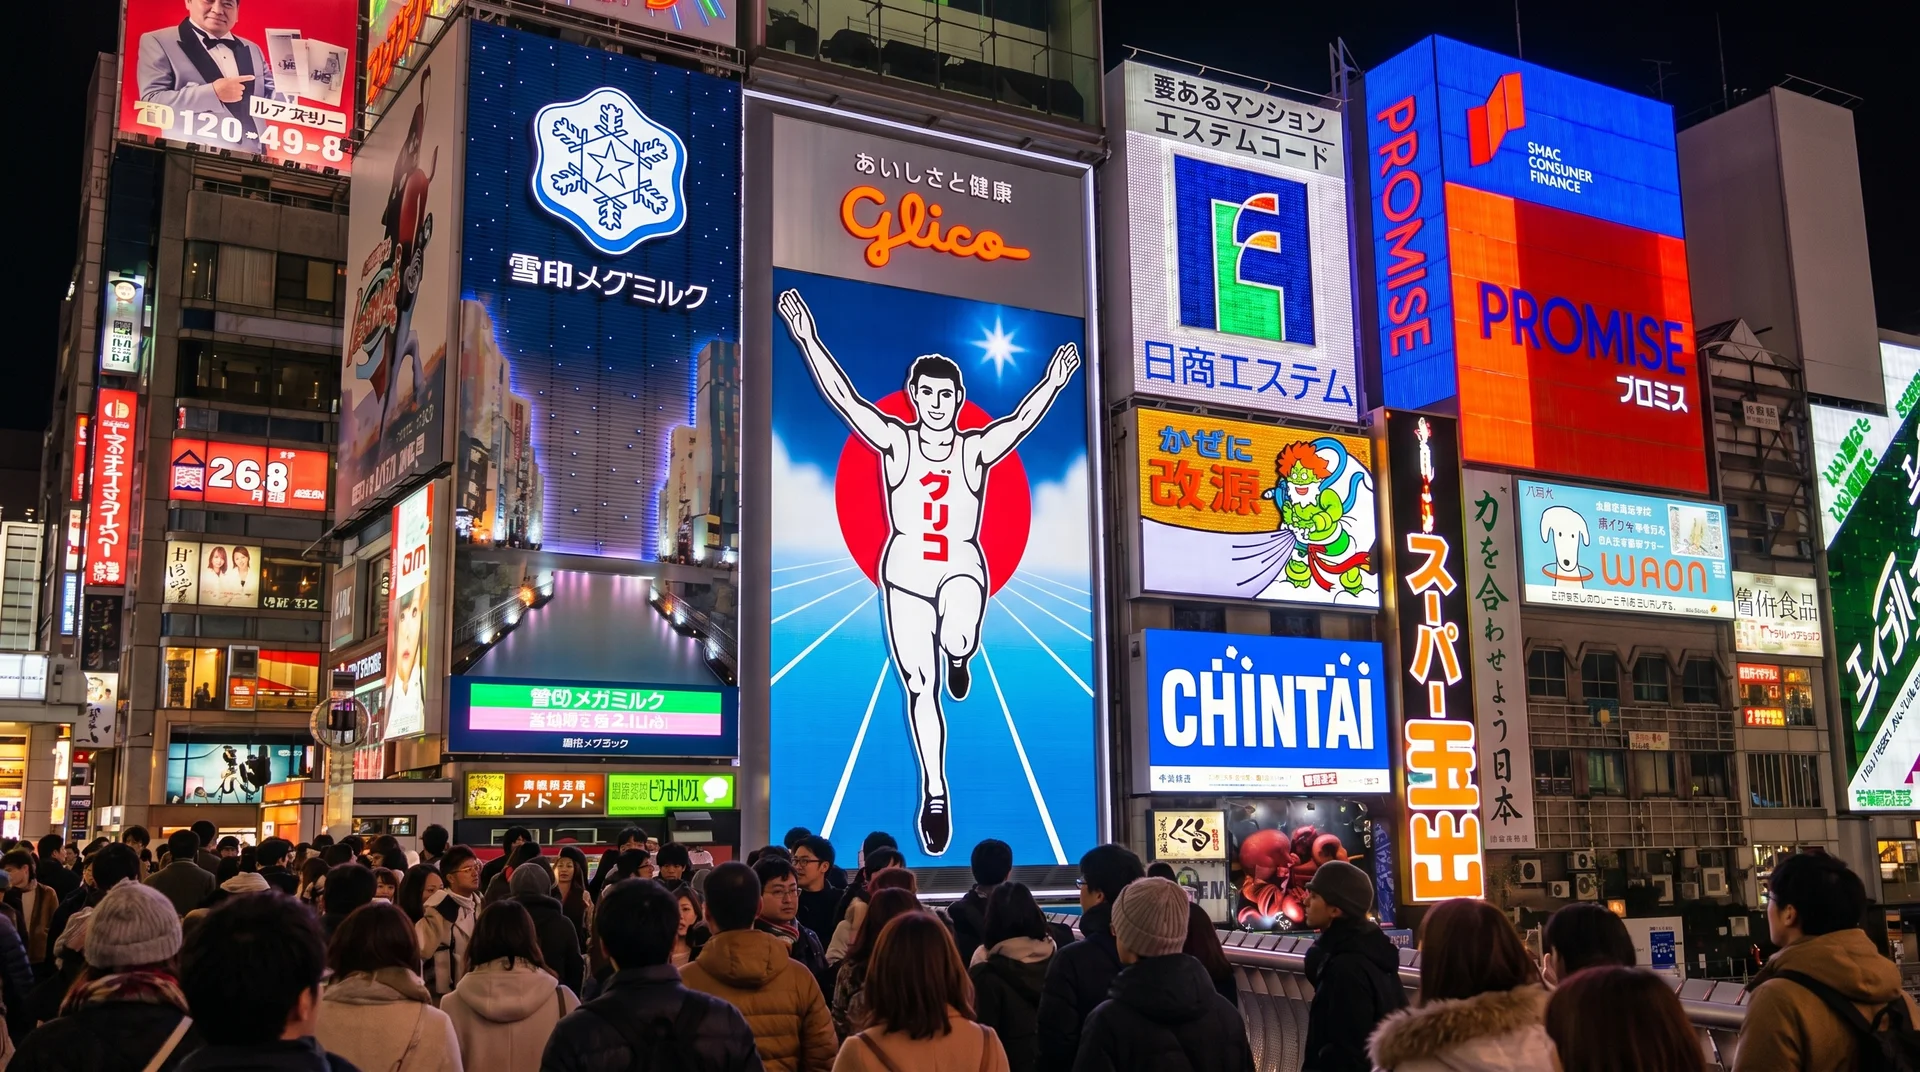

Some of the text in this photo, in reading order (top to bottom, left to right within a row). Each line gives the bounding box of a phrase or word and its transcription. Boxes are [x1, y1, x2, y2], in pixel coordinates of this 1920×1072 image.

[1155, 111, 1328, 169] エステムコード
[1527, 141, 1562, 162] SMAC
[855, 152, 1012, 203] あいしさと健康
[1528, 156, 1593, 183] CONSUNER
[1530, 169, 1582, 194] FINANCE
[840, 185, 1031, 268] Glico
[1376, 94, 1432, 357] PROMISE
[509, 252, 708, 309] 雪印メグミルク
[1477, 281, 1686, 376] PROMISE
[1145, 340, 1353, 406] 日商エステム
[1616, 375, 1688, 413] プロミス
[1159, 426, 1253, 462] かぜに
[1150, 458, 1262, 515] 改源
[919, 469, 951, 562] グリコ
[1473, 489, 1523, 827] 力を合わせよう日本
[1161, 657, 1375, 750] CHINTAI
[1404, 532, 1485, 902] スーパー玉出
[514, 792, 596, 809] アドアド
